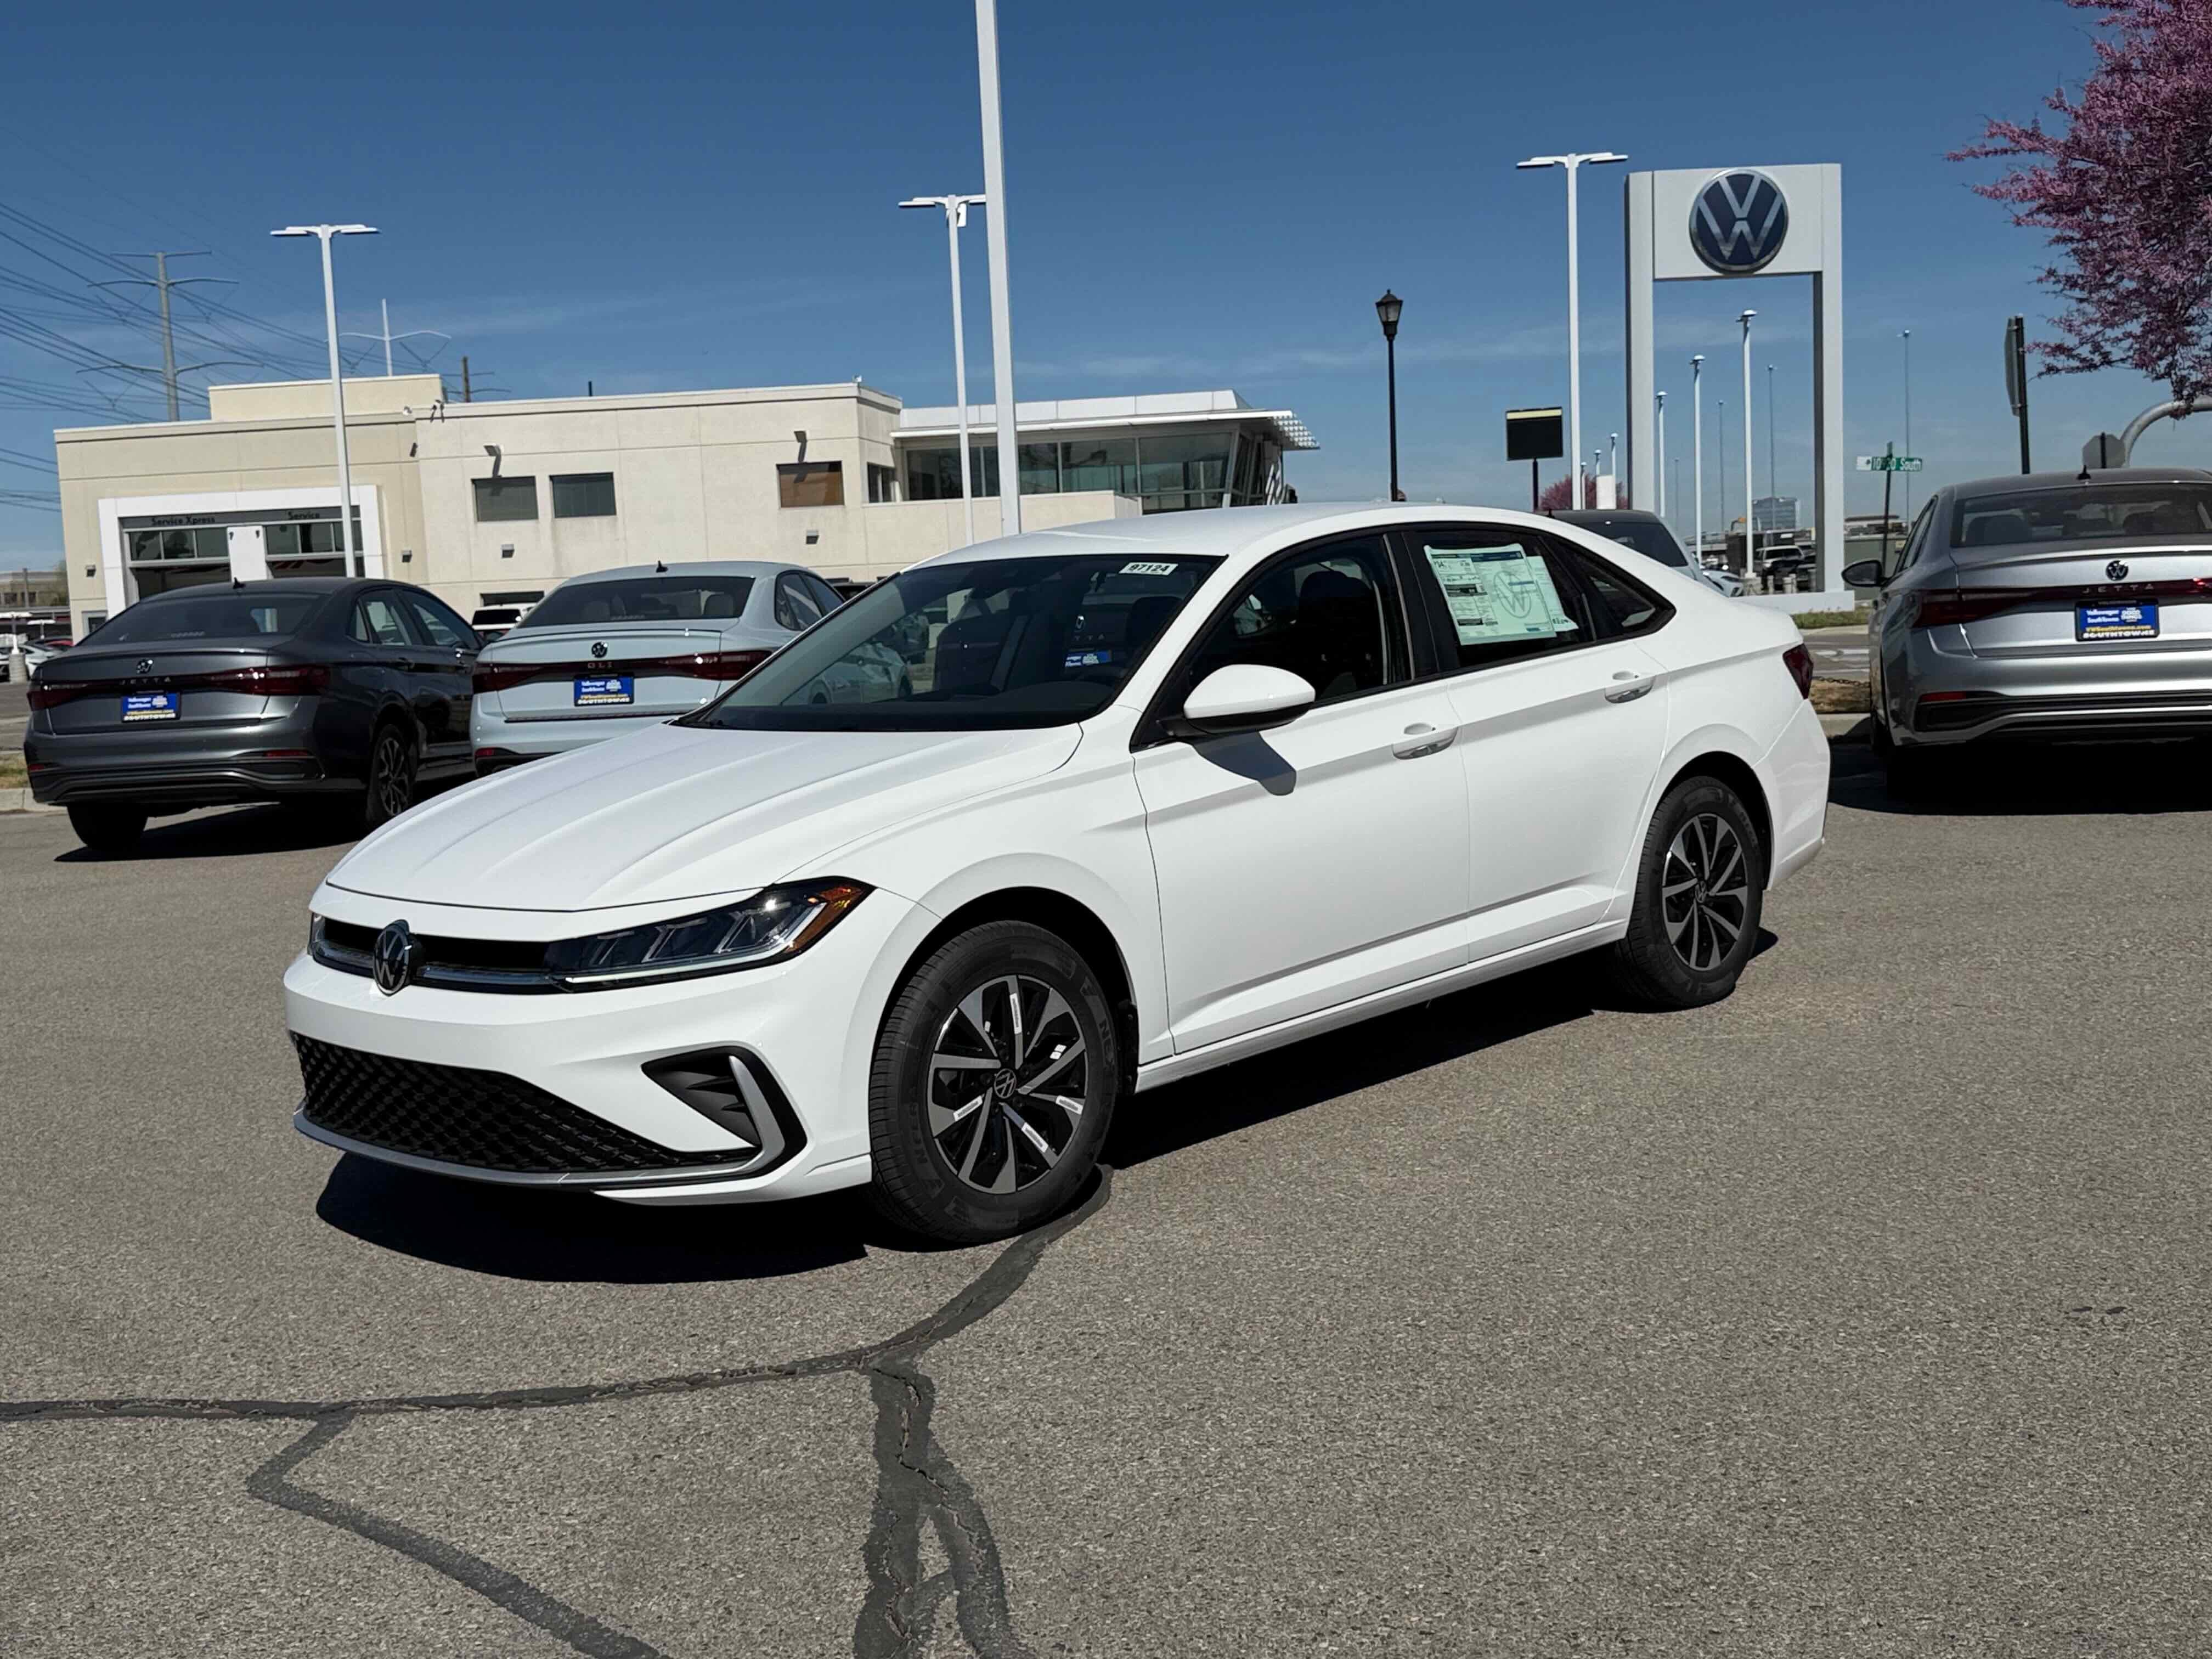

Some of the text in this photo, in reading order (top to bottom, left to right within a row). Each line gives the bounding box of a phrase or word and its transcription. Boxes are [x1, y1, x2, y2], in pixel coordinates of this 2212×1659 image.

[1900, 457, 1921, 470] South
[288, 511, 320, 520] Service
[151, 516, 215, 526] Service Xpress
[2082, 583, 2154, 594] JETTA
